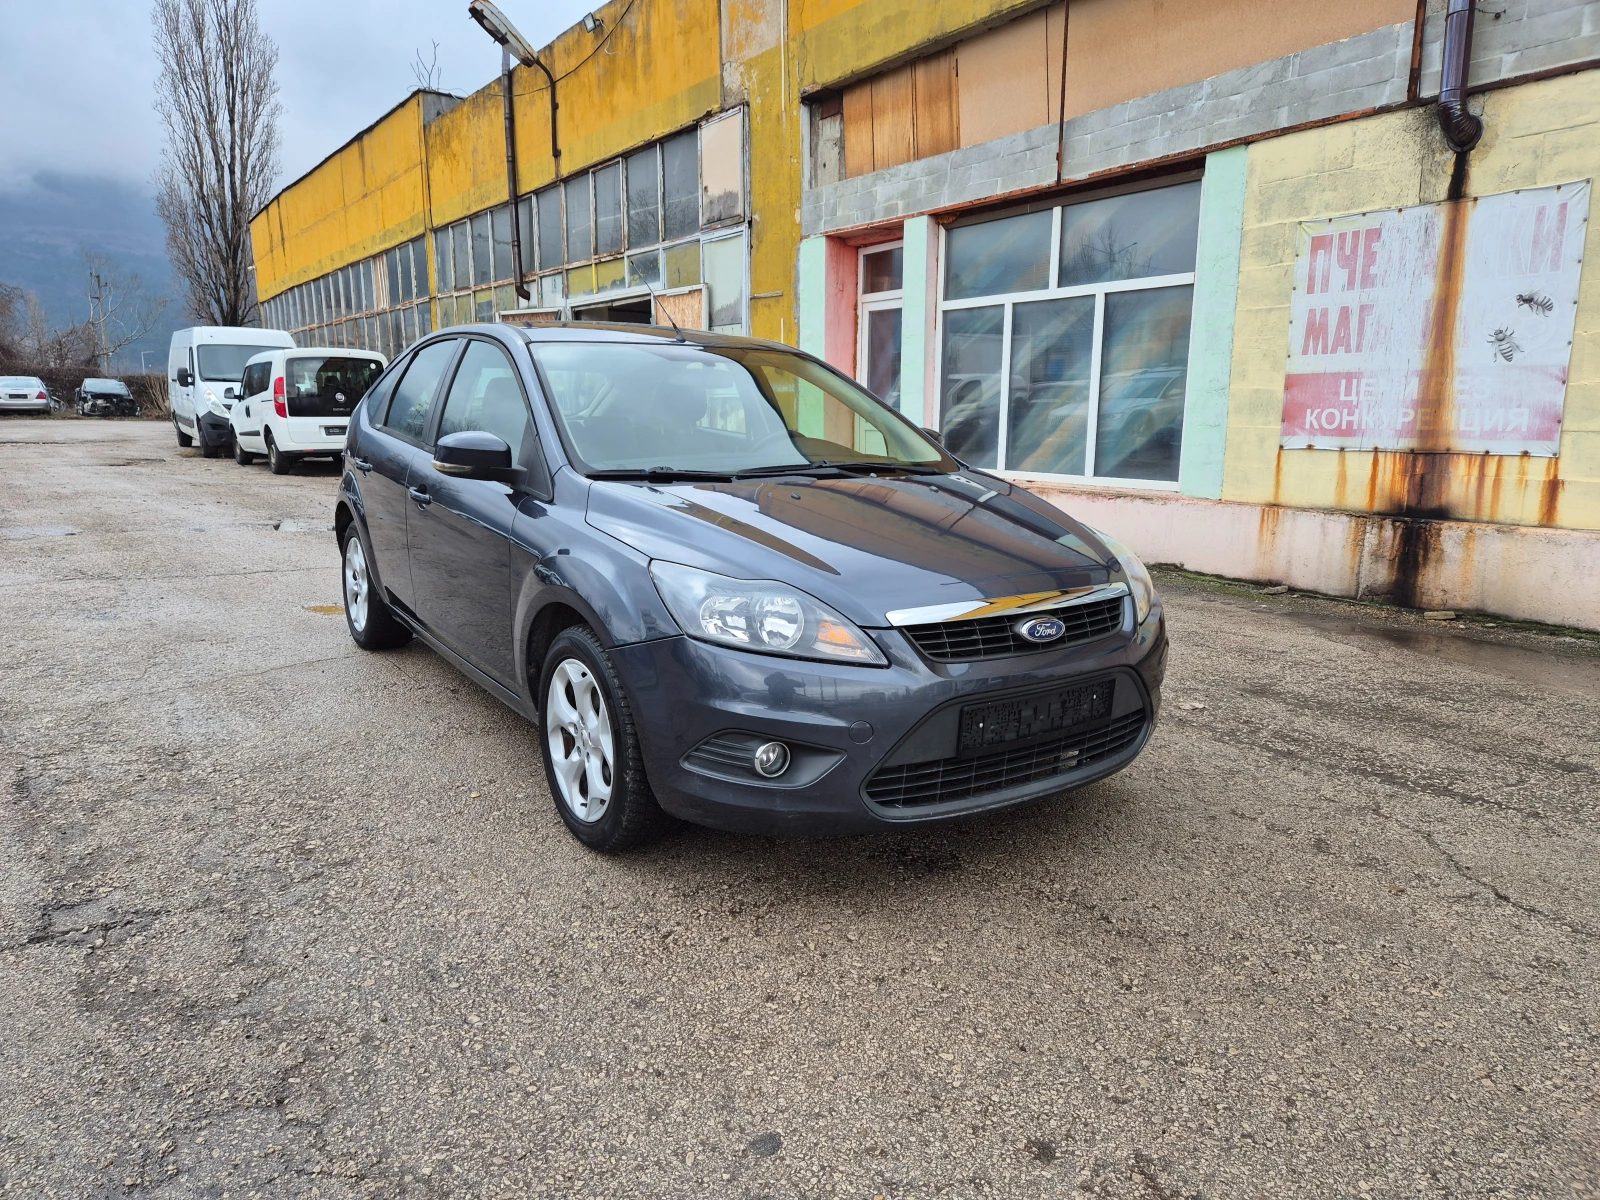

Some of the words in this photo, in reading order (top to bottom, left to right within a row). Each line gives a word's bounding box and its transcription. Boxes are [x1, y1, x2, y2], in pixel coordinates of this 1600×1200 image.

[1306, 202, 1568, 295] ПЧЕКИ
[1301, 298, 1473, 356] МАГАИ
[1034, 623, 1057, 637] Ford
